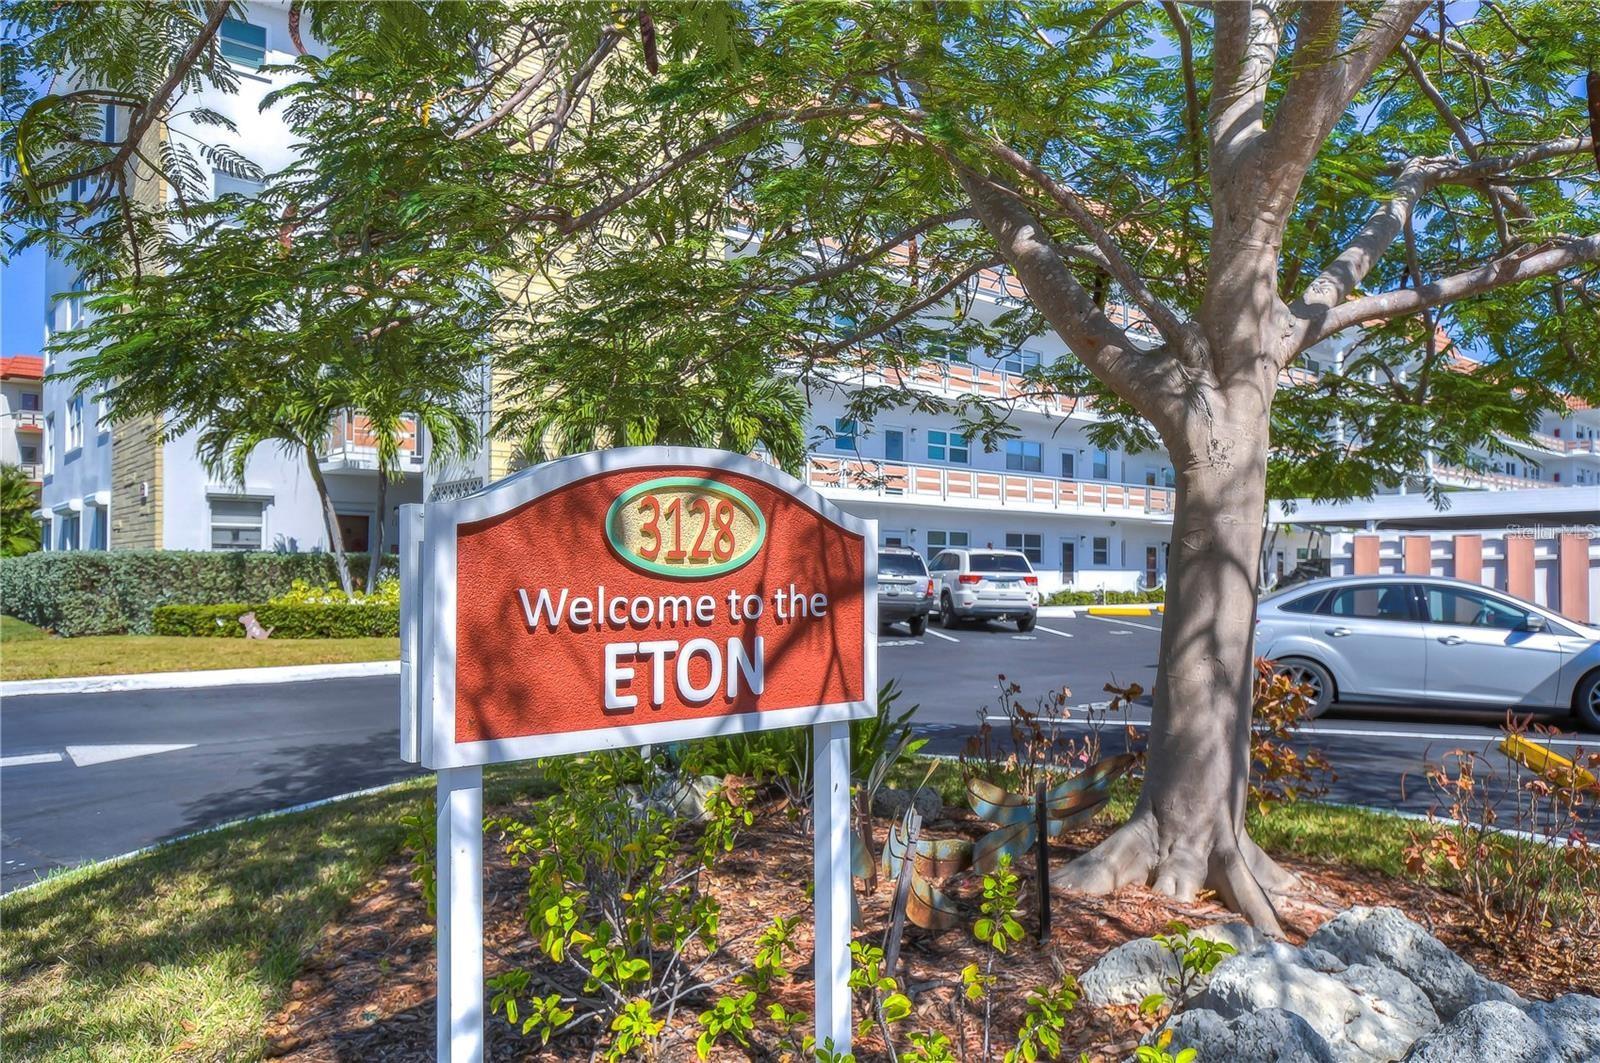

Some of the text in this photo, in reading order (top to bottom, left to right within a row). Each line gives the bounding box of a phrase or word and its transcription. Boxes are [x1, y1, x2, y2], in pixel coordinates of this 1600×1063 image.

[638, 495, 736, 560] 3128
[519, 584, 828, 627] Welcome to the
[604, 637, 765, 710] ETON
